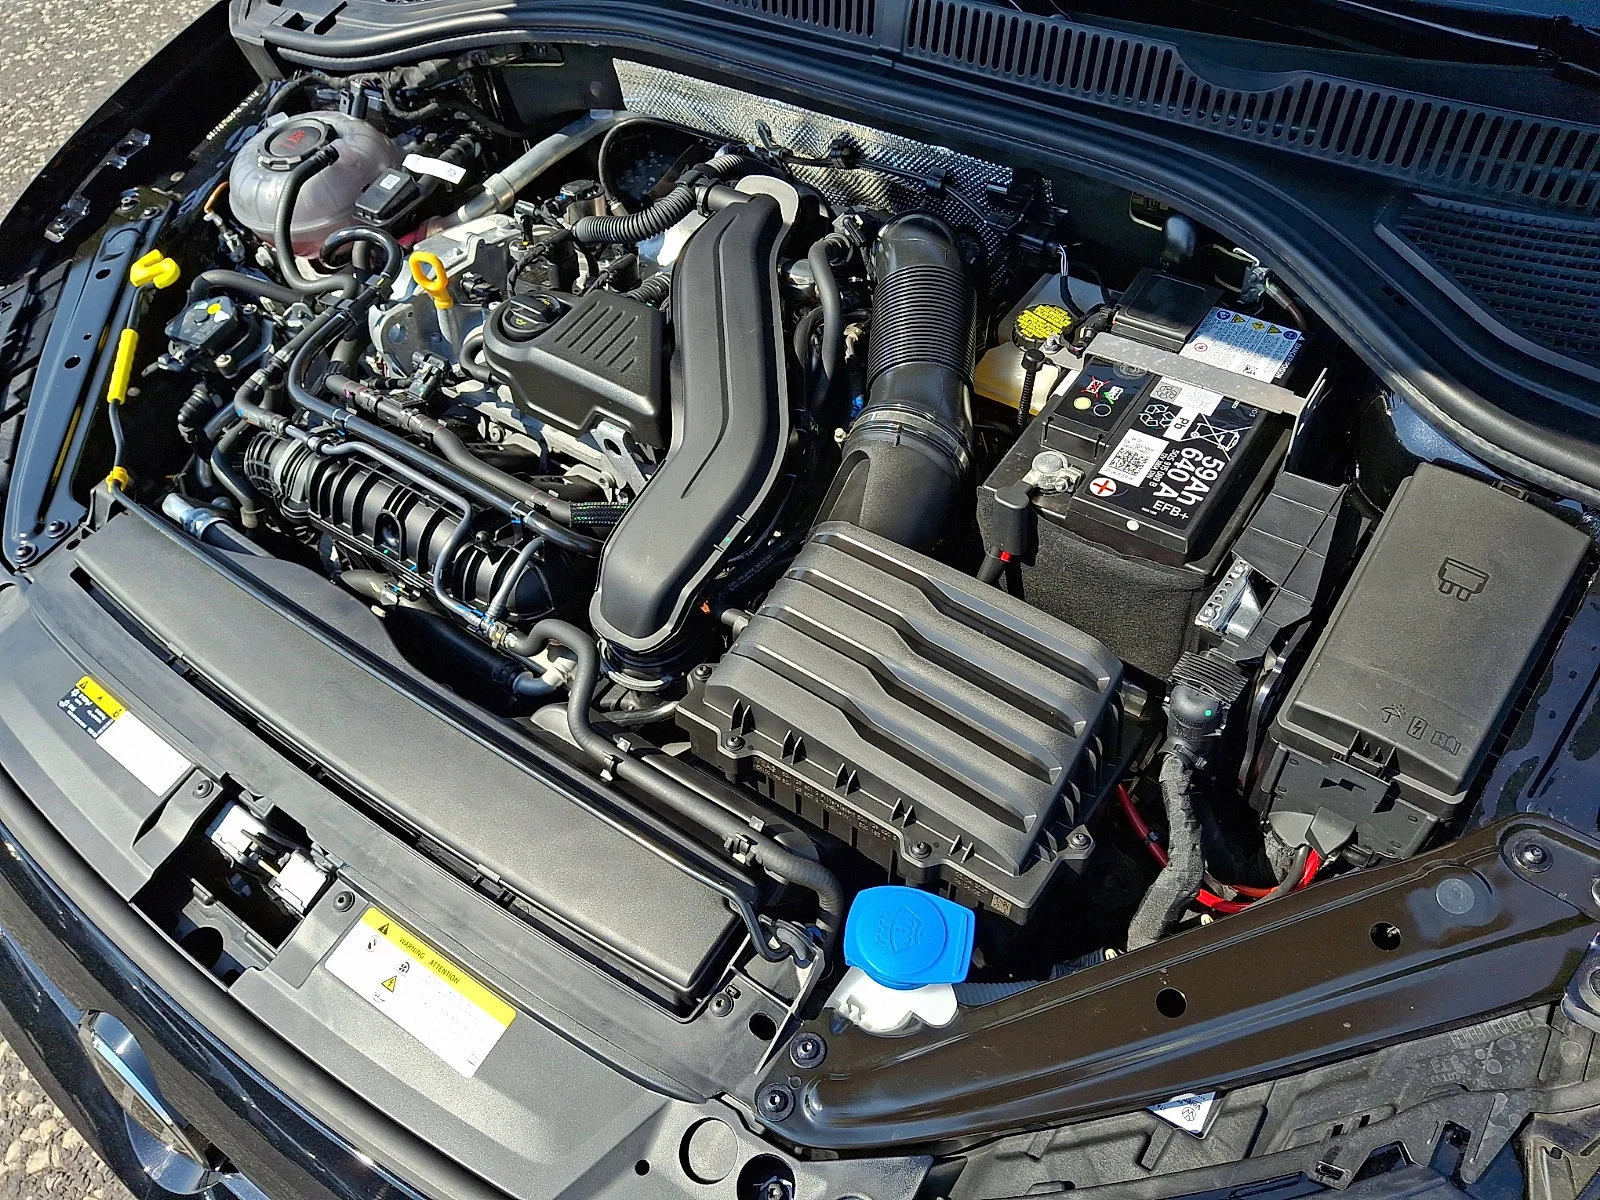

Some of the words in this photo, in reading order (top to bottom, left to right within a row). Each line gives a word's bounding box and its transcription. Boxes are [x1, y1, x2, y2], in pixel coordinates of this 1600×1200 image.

[1174, 418, 1189, 429] Pb
[1160, 461, 1171, 471] 915
[1167, 447, 1203, 482] 640
[1152, 471, 1165, 482] 089
[1176, 456, 1226, 505] 59Ah
[1153, 481, 1179, 498] A
[1153, 500, 1189, 519] EFB+
[400, 937, 425, 959] WARNING
[429, 960, 460, 984] ATTENTION
